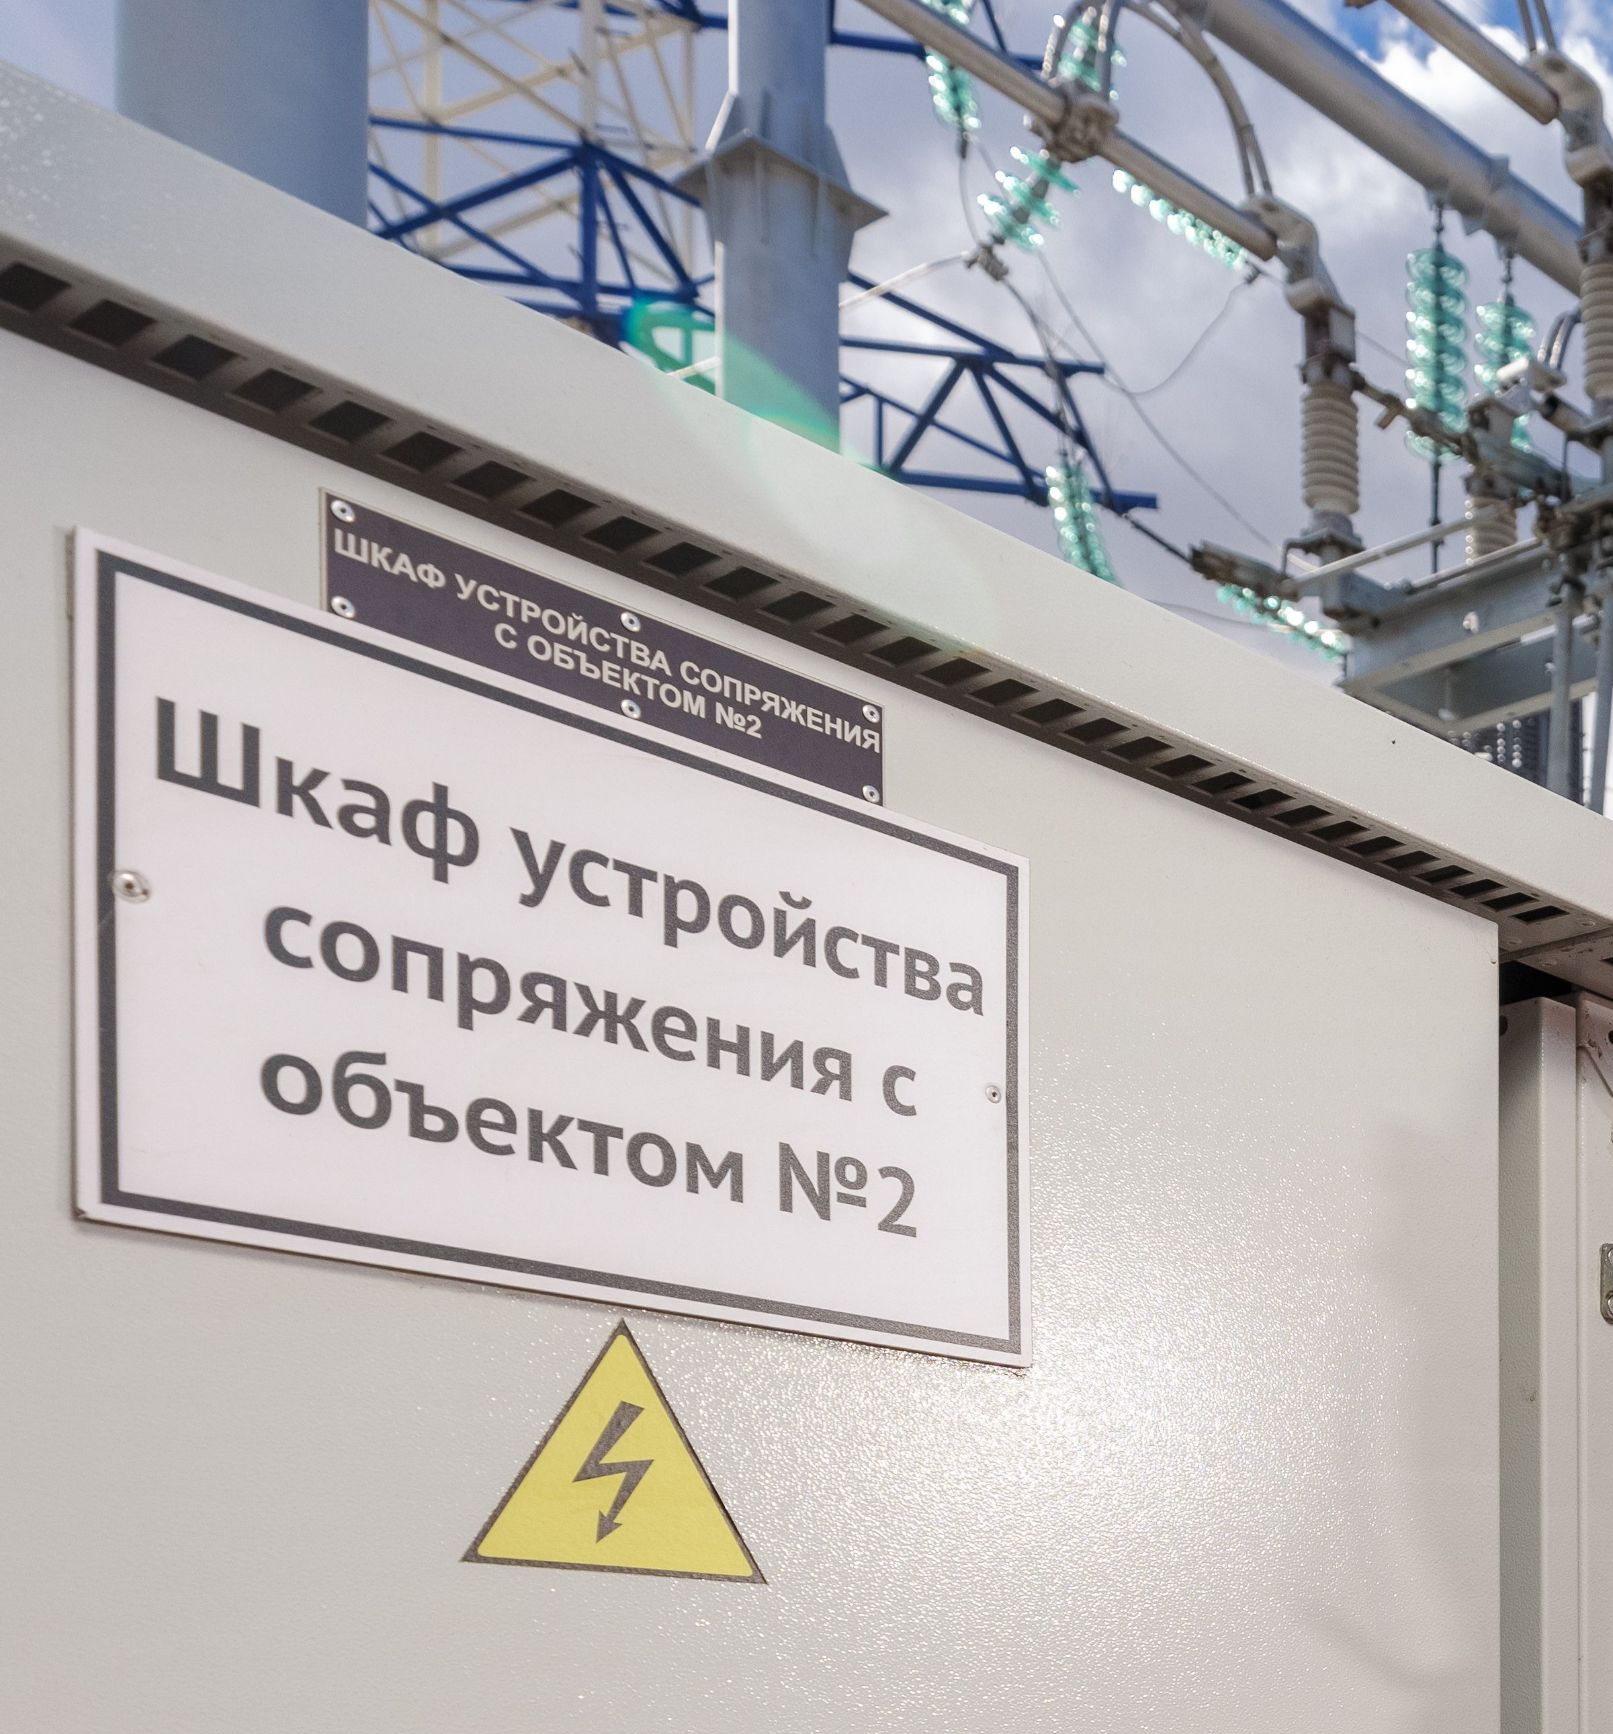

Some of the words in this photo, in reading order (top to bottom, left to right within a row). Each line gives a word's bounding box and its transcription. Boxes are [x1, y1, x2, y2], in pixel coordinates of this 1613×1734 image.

[332, 528, 446, 591] ШКАФ
[454, 573, 672, 676] УСТРОЙСТВА
[679, 658, 883, 755] СОПРЯЖЕНИЯ
[493, 621, 519, 652] С
[526, 630, 707, 720] ОБЪЕКТОМ
[714, 698, 763, 740] №2
[154, 696, 480, 882] Шкаф
[509, 825, 985, 1017] устройства
[262, 903, 853, 1102] сопряжения
[882, 1058, 918, 1117] с
[259, 1048, 744, 1204] объектом
[778, 1140, 918, 1238] №2
